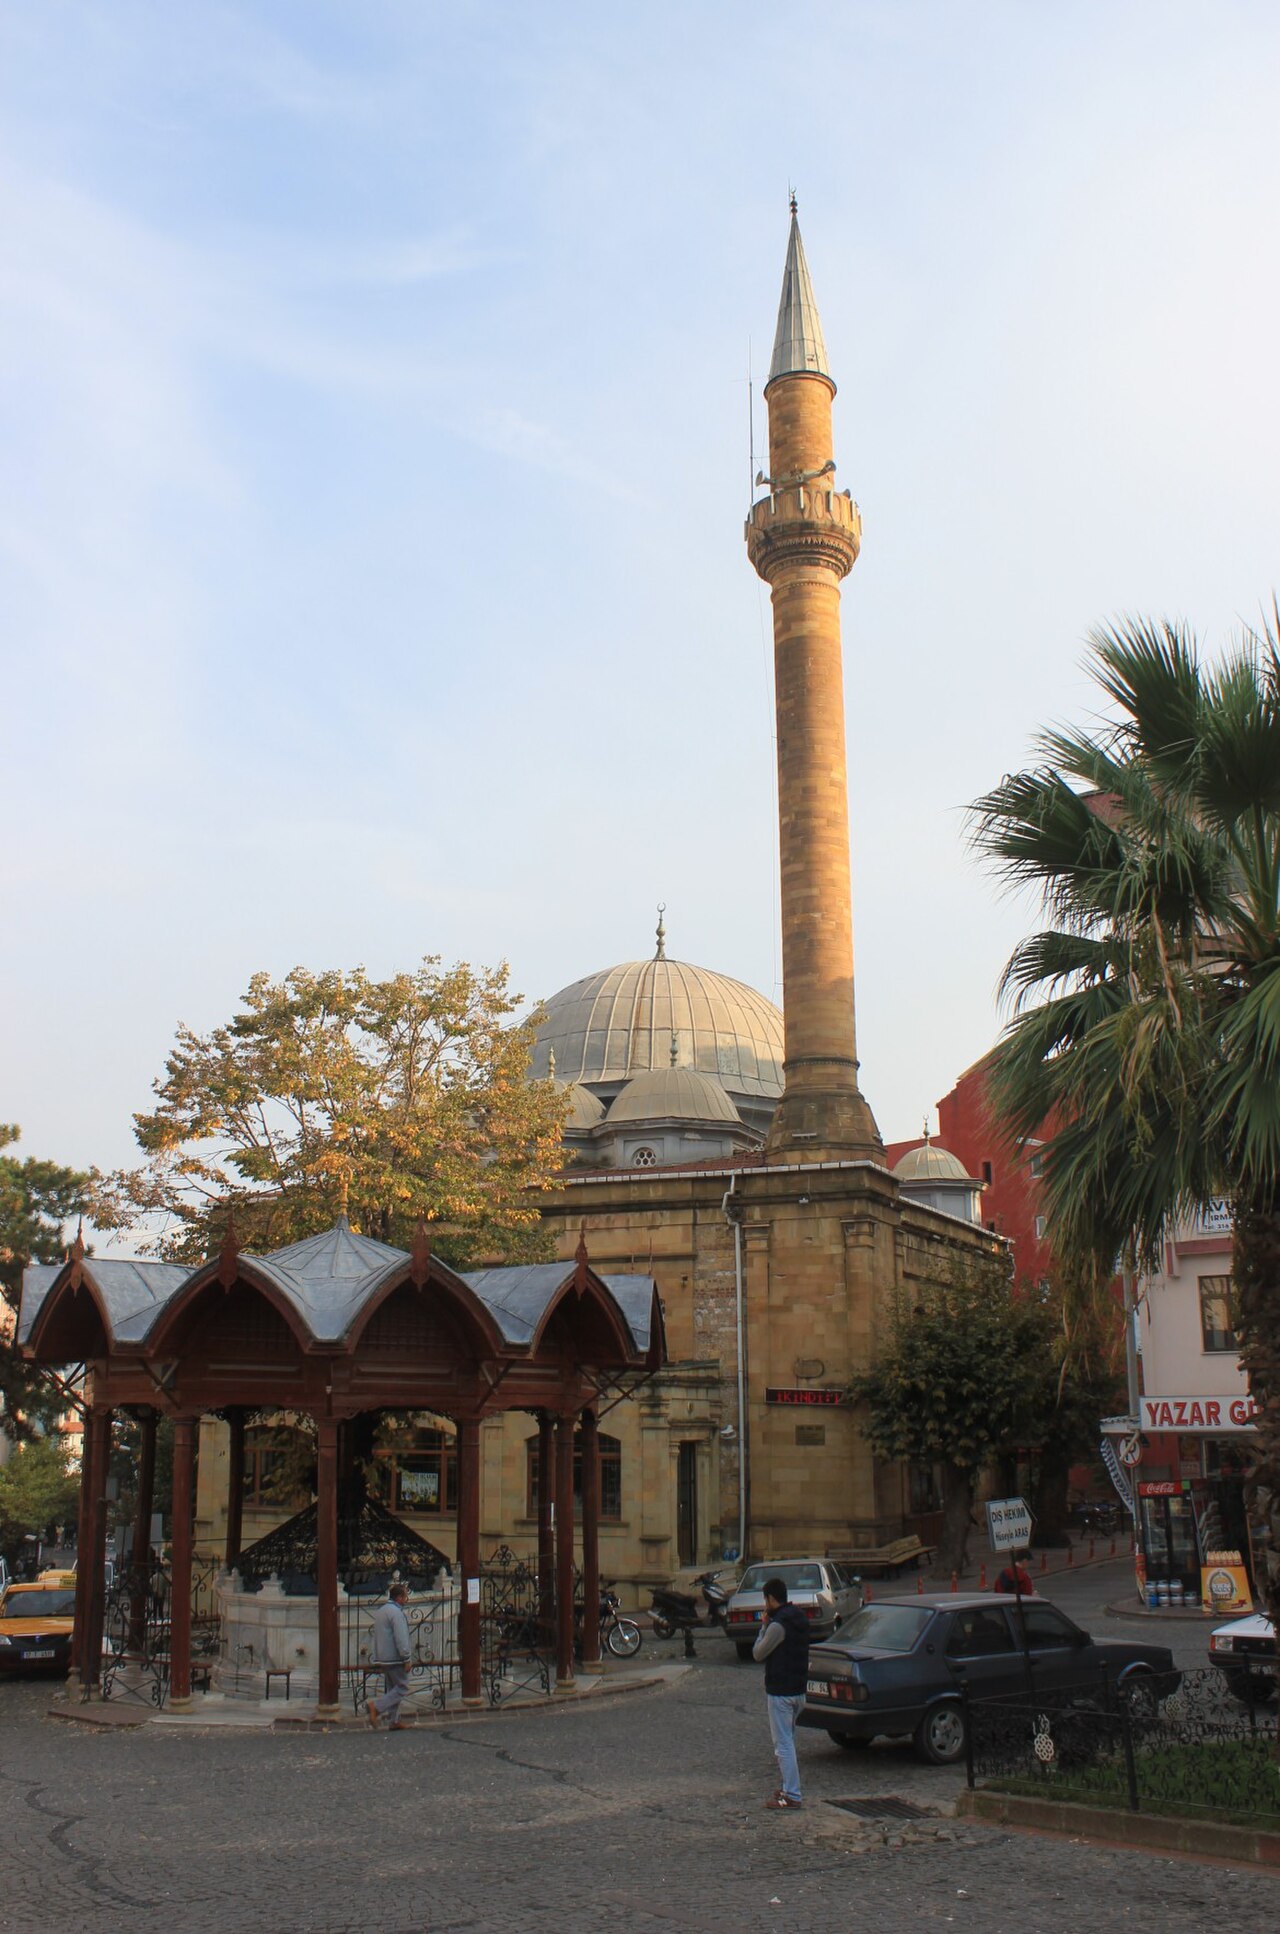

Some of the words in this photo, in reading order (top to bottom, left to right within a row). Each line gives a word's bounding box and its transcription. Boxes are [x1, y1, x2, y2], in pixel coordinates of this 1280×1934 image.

[1145, 1401, 1221, 1427] YAZAR
[992, 1508, 1003, 1524] DİŞ
[1015, 1527, 1028, 1538] ARAS
